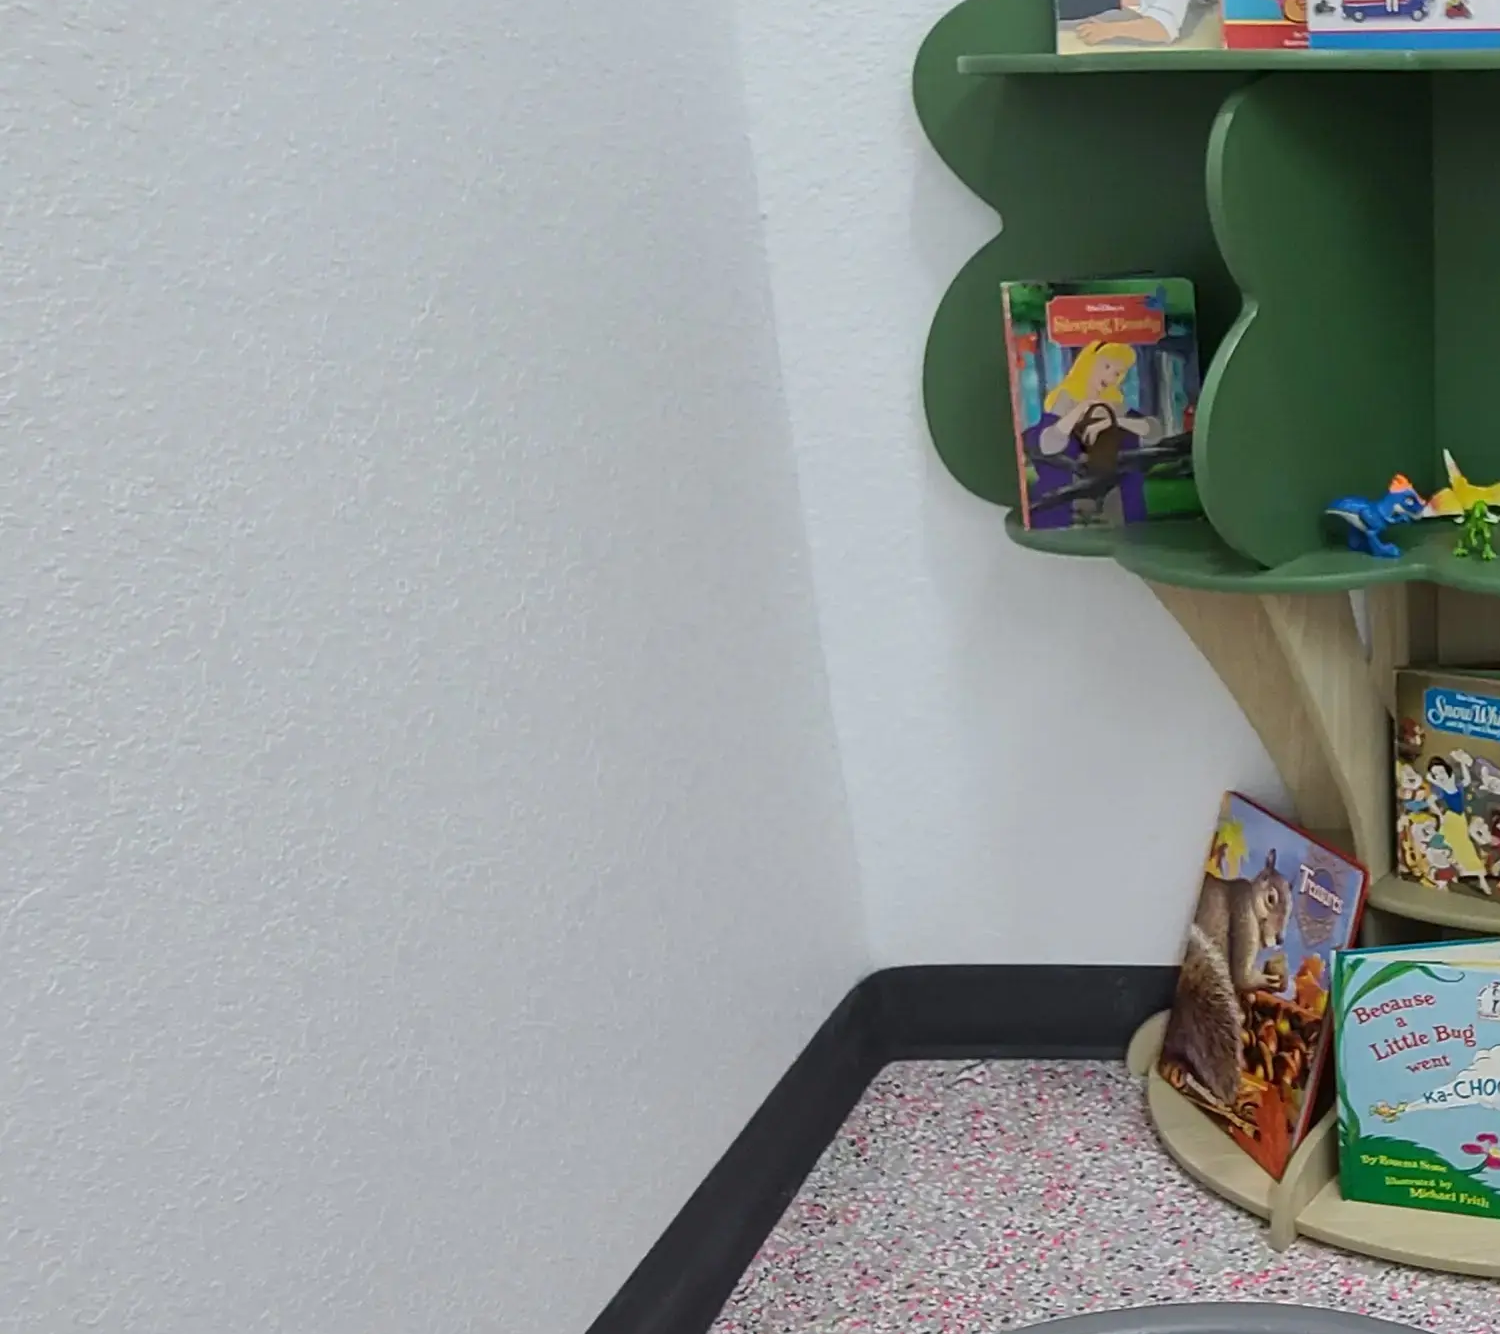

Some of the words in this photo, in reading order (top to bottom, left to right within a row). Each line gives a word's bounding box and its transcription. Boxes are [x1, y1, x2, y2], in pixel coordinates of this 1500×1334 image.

[1428, 695, 1474, 725] Snow
[1352, 993, 1436, 1024] Because
[1395, 1017, 1407, 1027] a
[1369, 1031, 1430, 1061] Little
[1433, 1023, 1476, 1047] Bug
[1406, 1054, 1451, 1073] went
[1360, 1155, 1378, 1166] By
[1409, 1187, 1457, 1202] Michael
